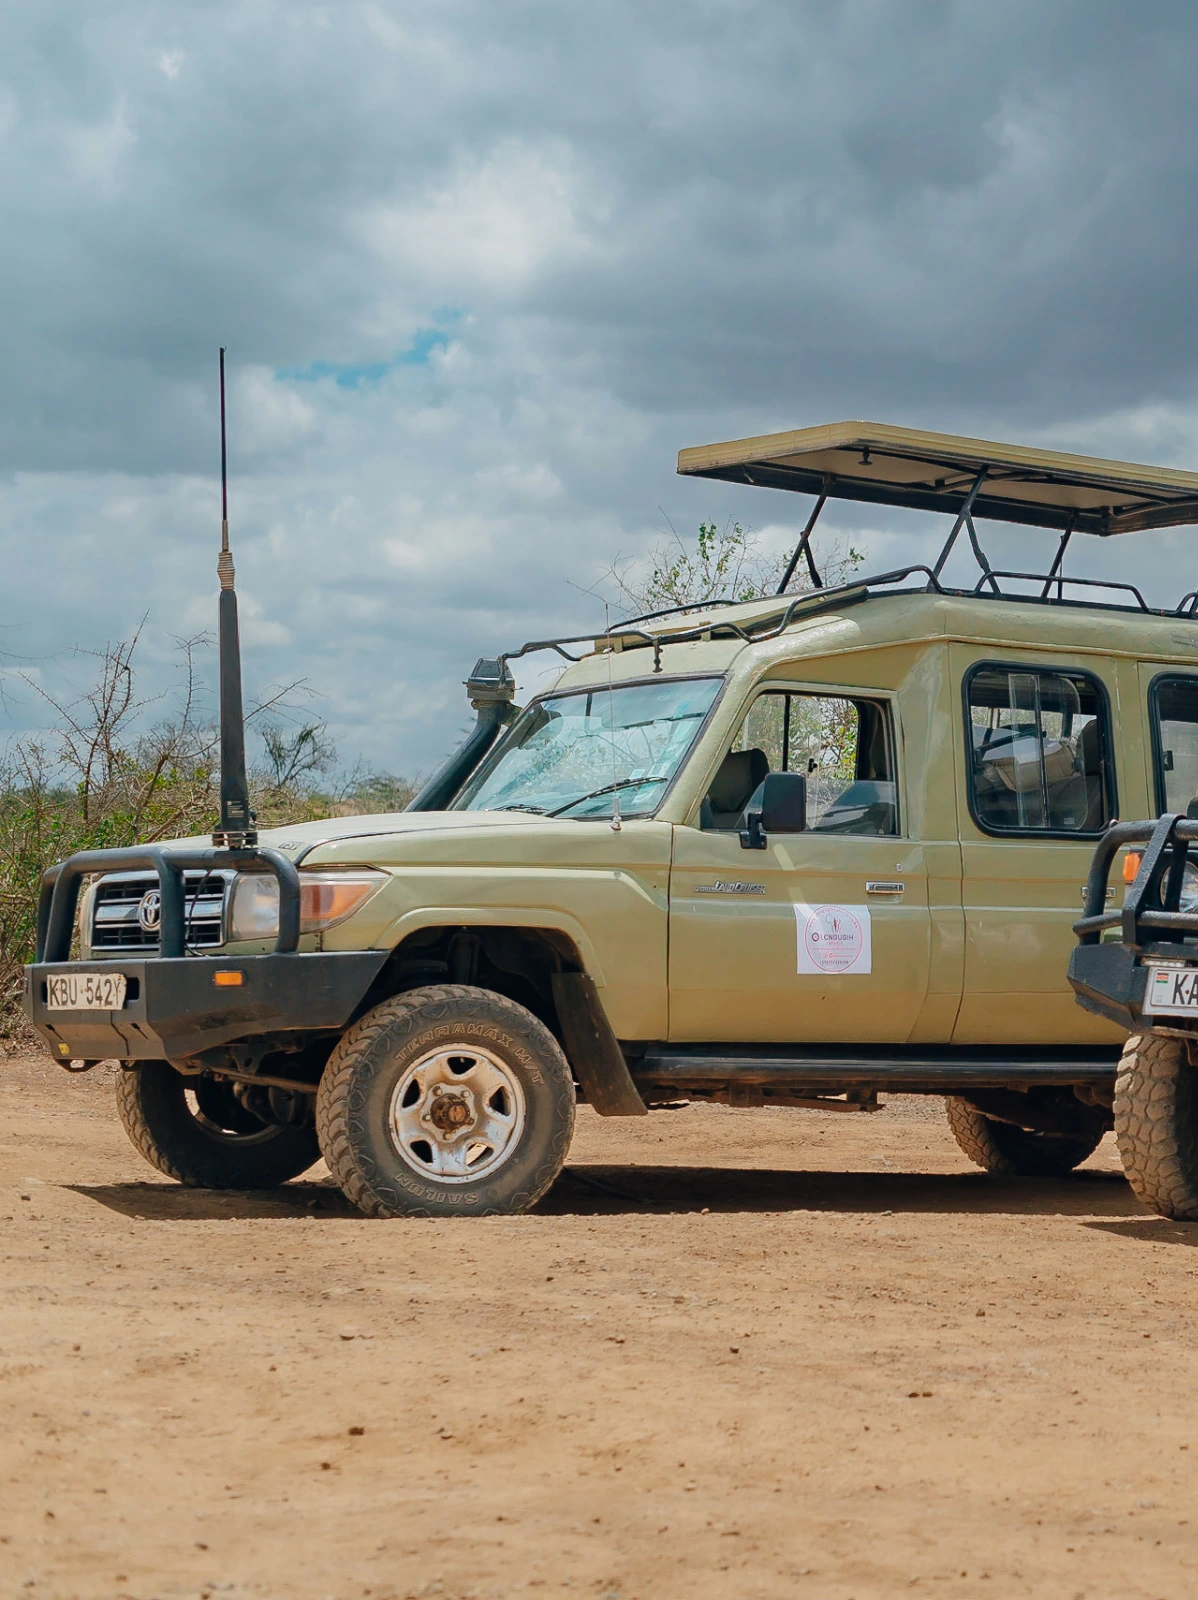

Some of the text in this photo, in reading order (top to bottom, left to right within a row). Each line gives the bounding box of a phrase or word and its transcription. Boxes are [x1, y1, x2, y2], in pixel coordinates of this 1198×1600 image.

[49, 977, 121, 1007] KBU 542Y
[395, 1023, 545, 1086] TERRAMAX M/T
[394, 1172, 480, 1205] SAILUN
